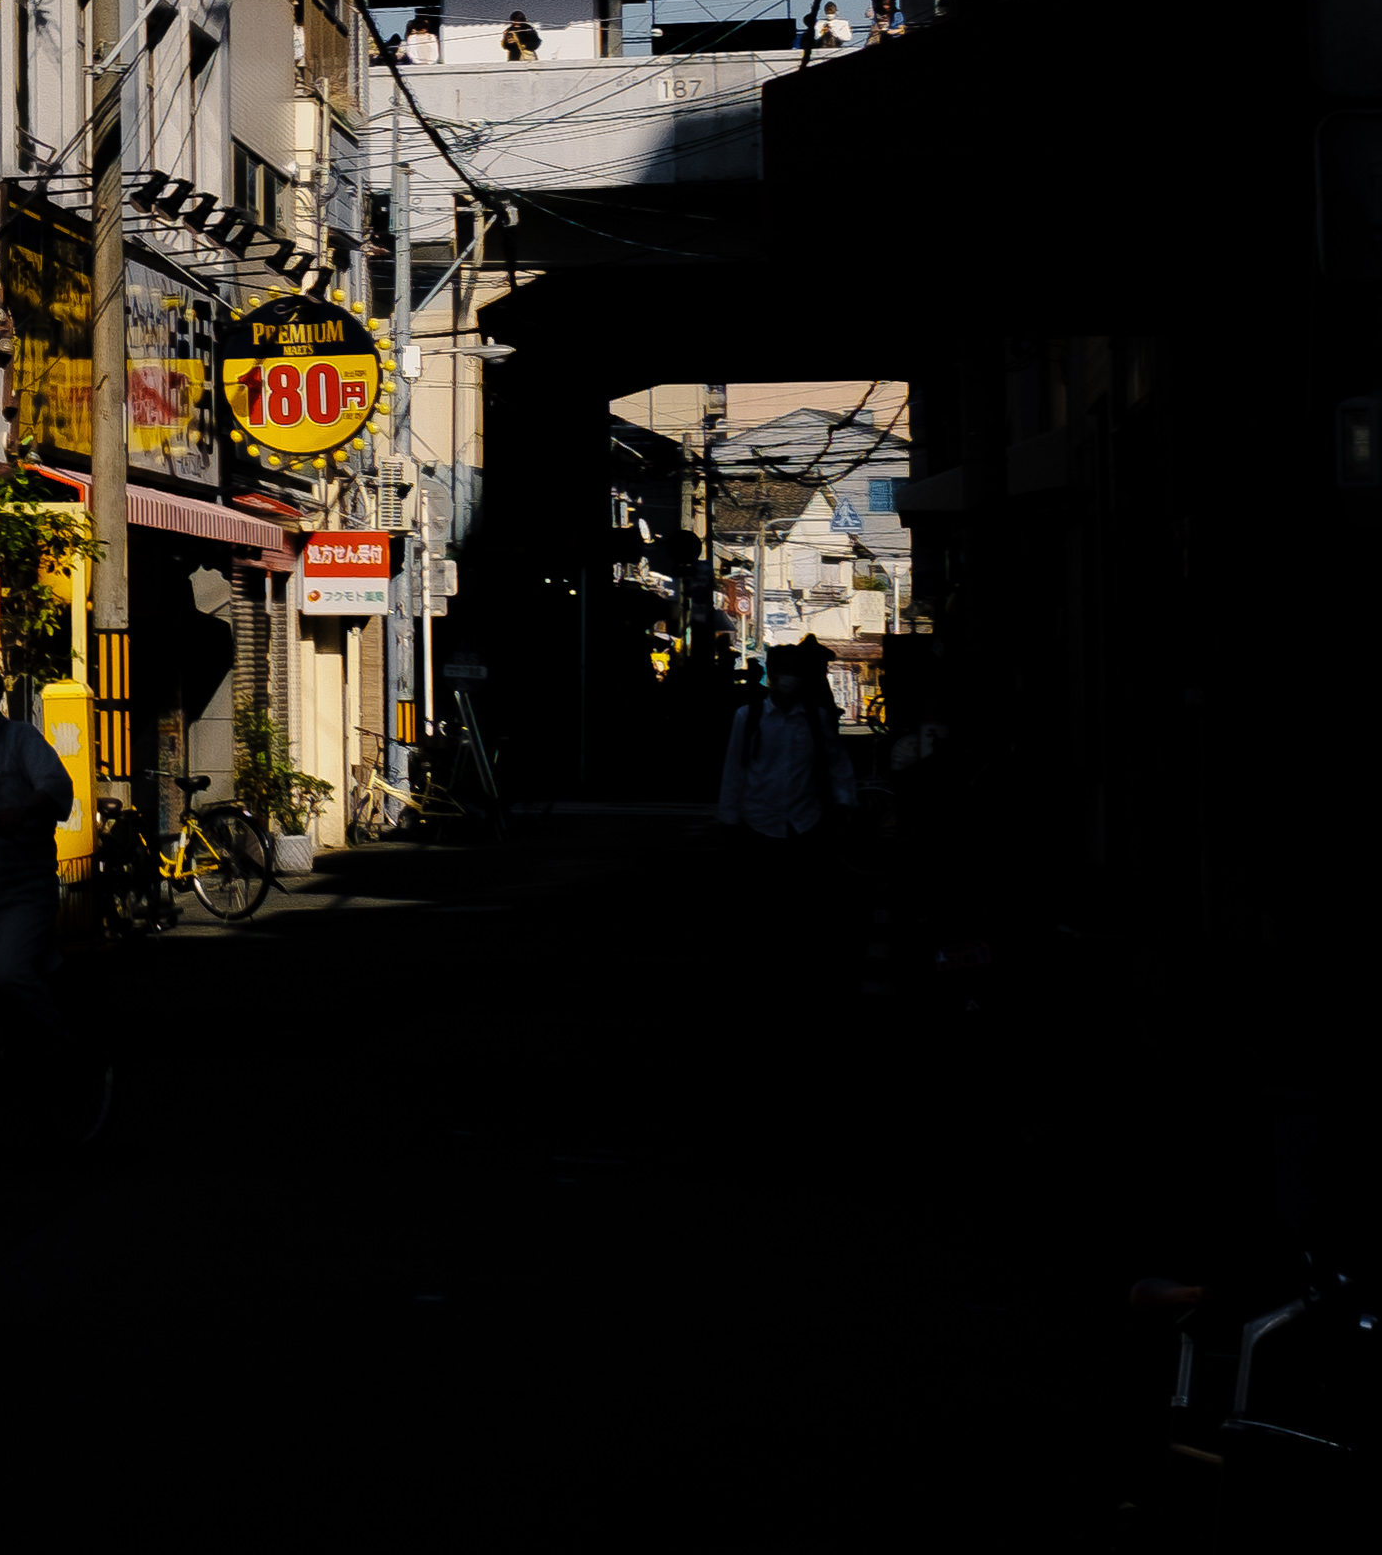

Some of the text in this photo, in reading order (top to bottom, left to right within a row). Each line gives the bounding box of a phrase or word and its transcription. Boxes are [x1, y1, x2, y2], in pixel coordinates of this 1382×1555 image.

[663, 79, 703, 99] 187
[252, 319, 345, 345] PREMIUM
[237, 362, 367, 427] 180円
[306, 544, 384, 565] 処方せん受付
